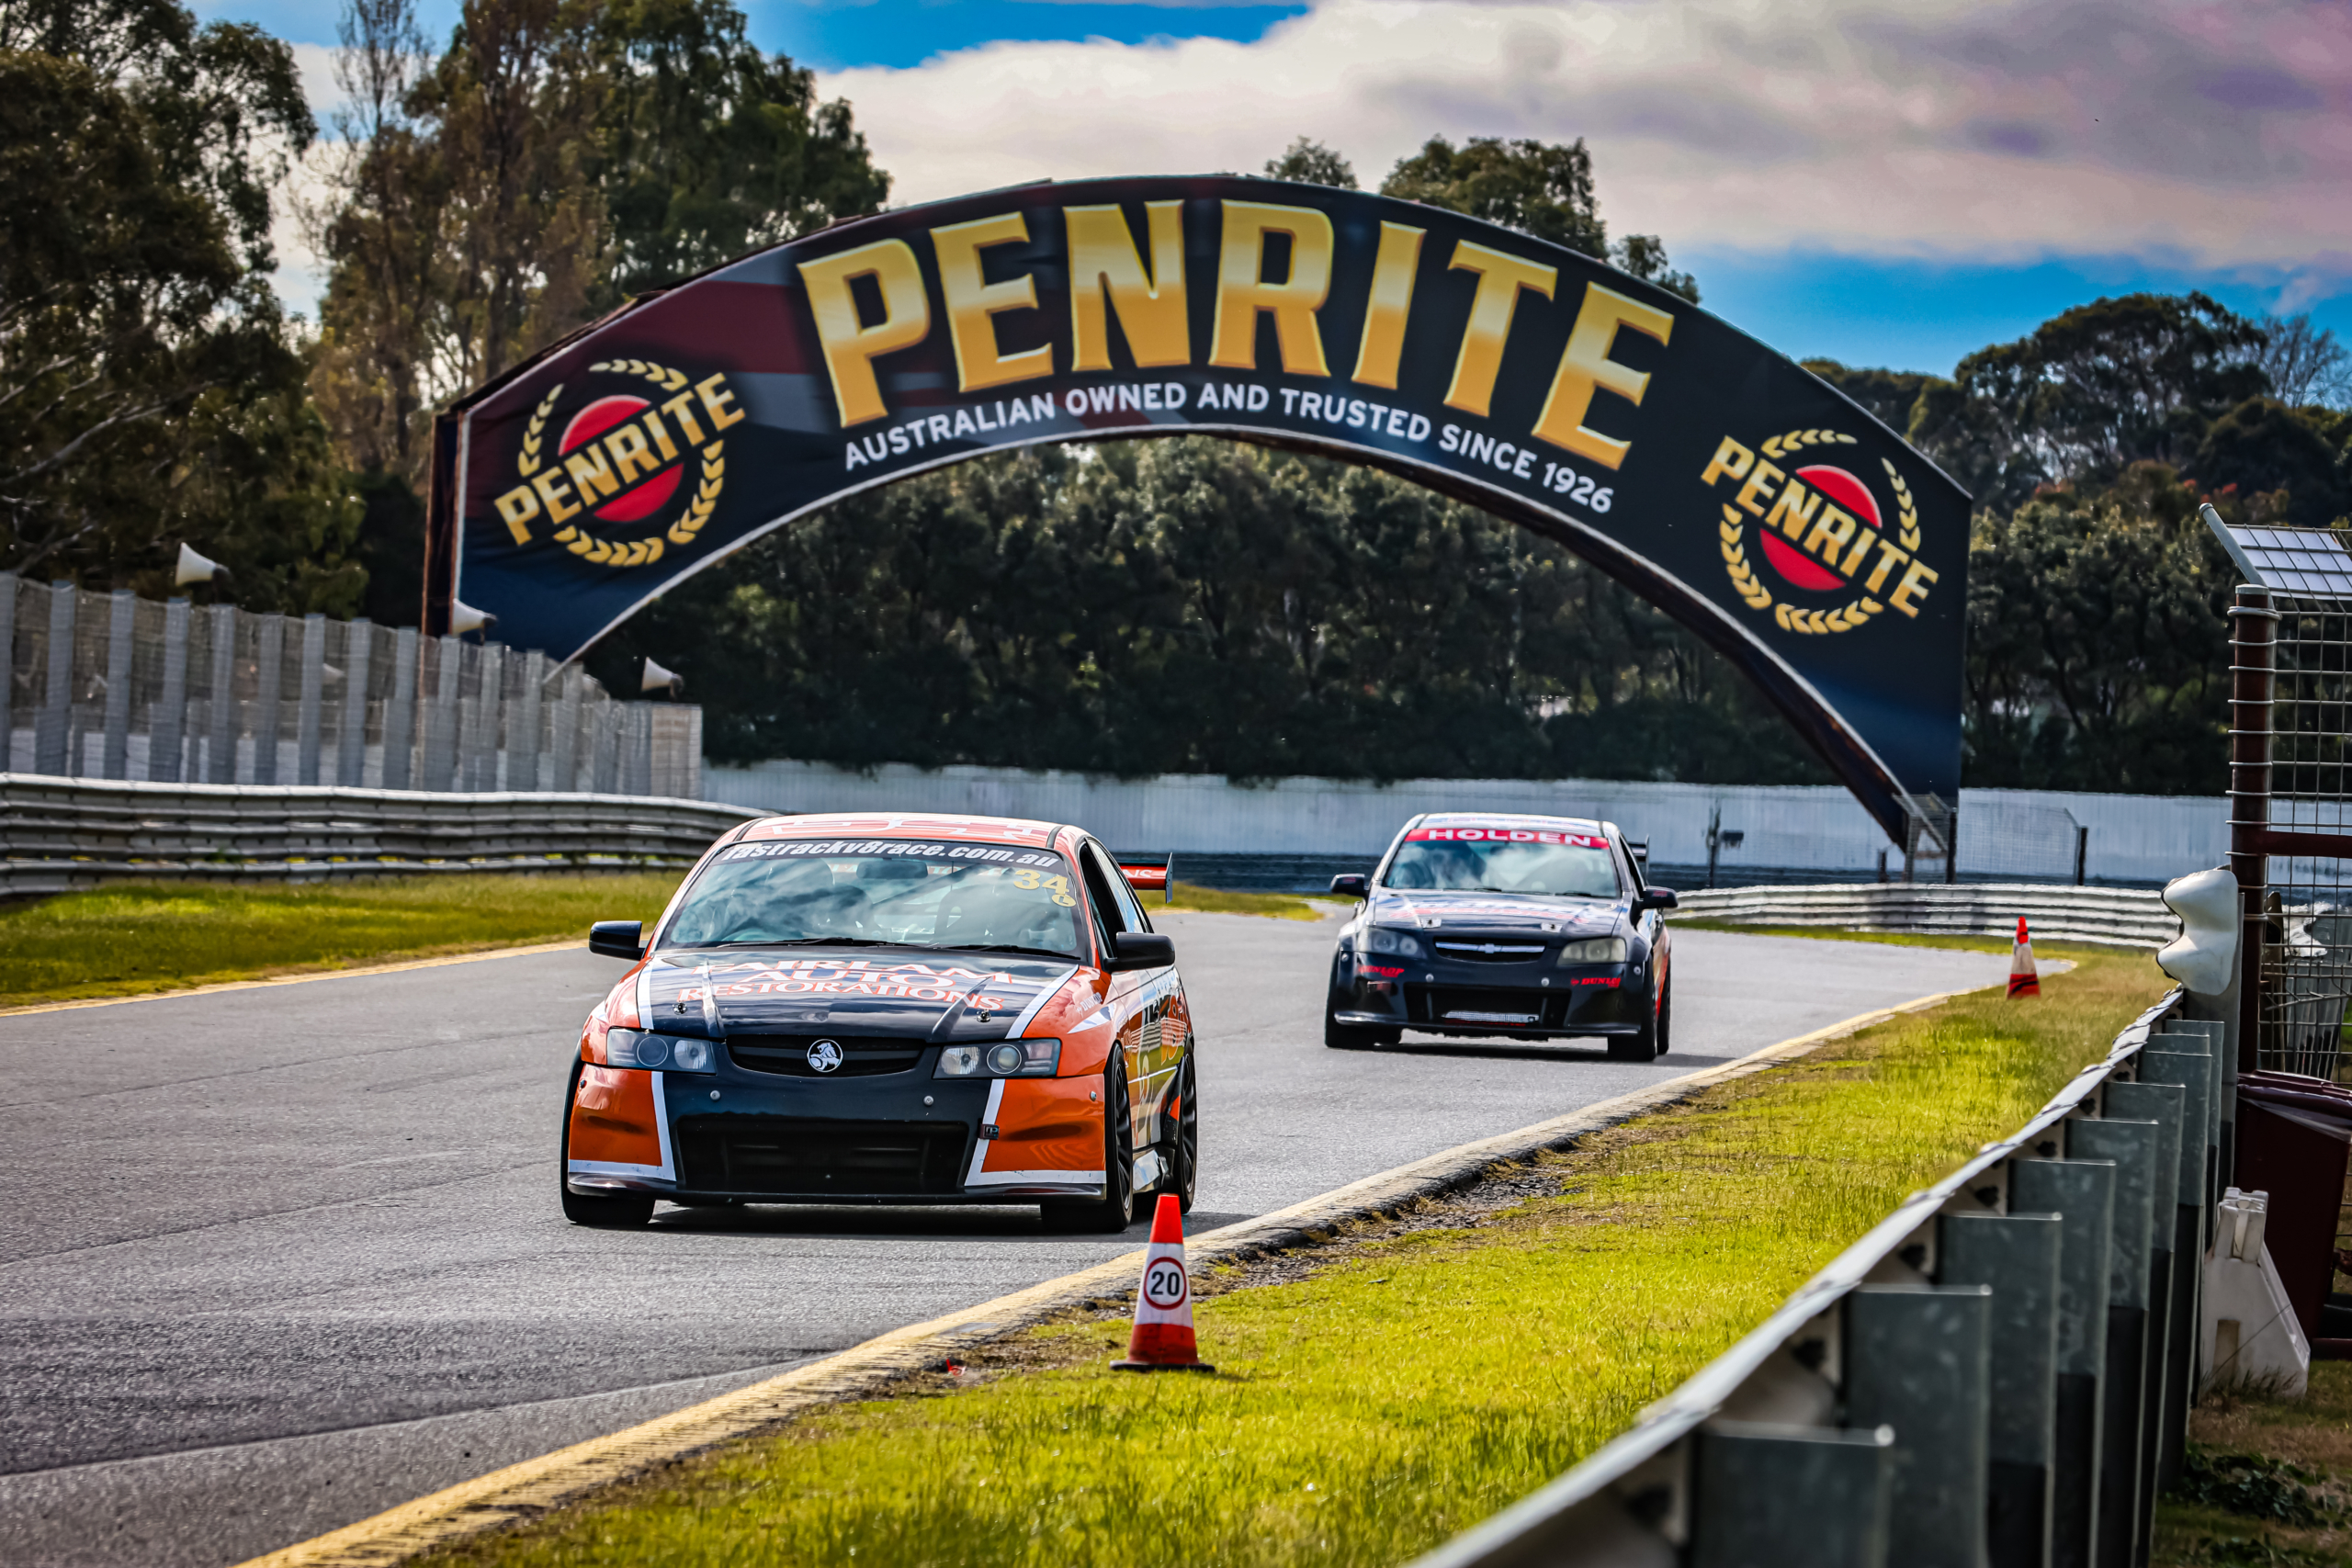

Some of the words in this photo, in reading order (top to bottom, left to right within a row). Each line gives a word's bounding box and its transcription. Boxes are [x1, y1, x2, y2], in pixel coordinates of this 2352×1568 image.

[797, 198, 1674, 479] PENRITE
[494, 371, 745, 546] PENRITE
[844, 391, 1056, 471] AUSTRALIAN
[1065, 382, 1187, 418] OWNED
[1197, 383, 1270, 412] AND
[1280, 388, 1431, 443] TRUSTED
[1438, 423, 1538, 479] SINCE
[1544, 462, 1614, 514] 1926
[1701, 435, 1939, 619] PENRITE
[1428, 828, 1591, 847] HOLDEN
[721, 840, 1059, 867] fastrackv8race.com.au
[1013, 866, 1069, 895] 34
[692, 960, 1012, 985] FAIRLAM
[736, 970, 956, 987] AUTO
[676, 981, 1005, 1010] RESTORATIONS
[1150, 1271, 1181, 1297] 20
